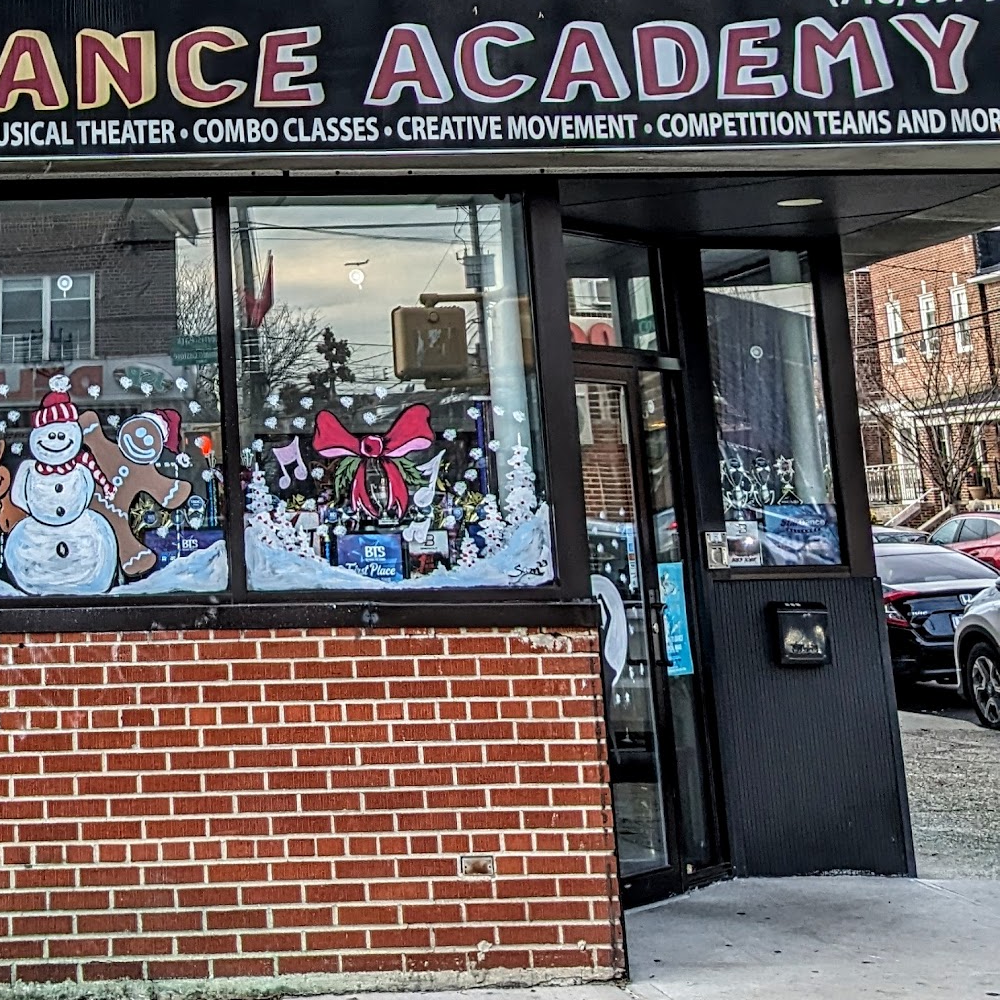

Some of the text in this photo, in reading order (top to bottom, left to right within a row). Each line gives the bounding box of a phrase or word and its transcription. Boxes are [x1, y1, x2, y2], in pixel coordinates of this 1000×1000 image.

[363, 13, 980, 107] ACADEMY
[76, 119, 177, 145] THEATER
[193, 117, 279, 144] COMBO
[283, 116, 380, 143] CLASSES
[396, 115, 503, 141] CREATIVE
[507, 114, 638, 140] MOVEMENT
[656, 110, 812, 139] COMPETITION
[812, 109, 892, 136] TEAMS
[896, 108, 947, 134] AND
[182, 539, 199, 549] BTS
[364, 545, 386, 558] BTS
[370, 562, 396, 576] Place
